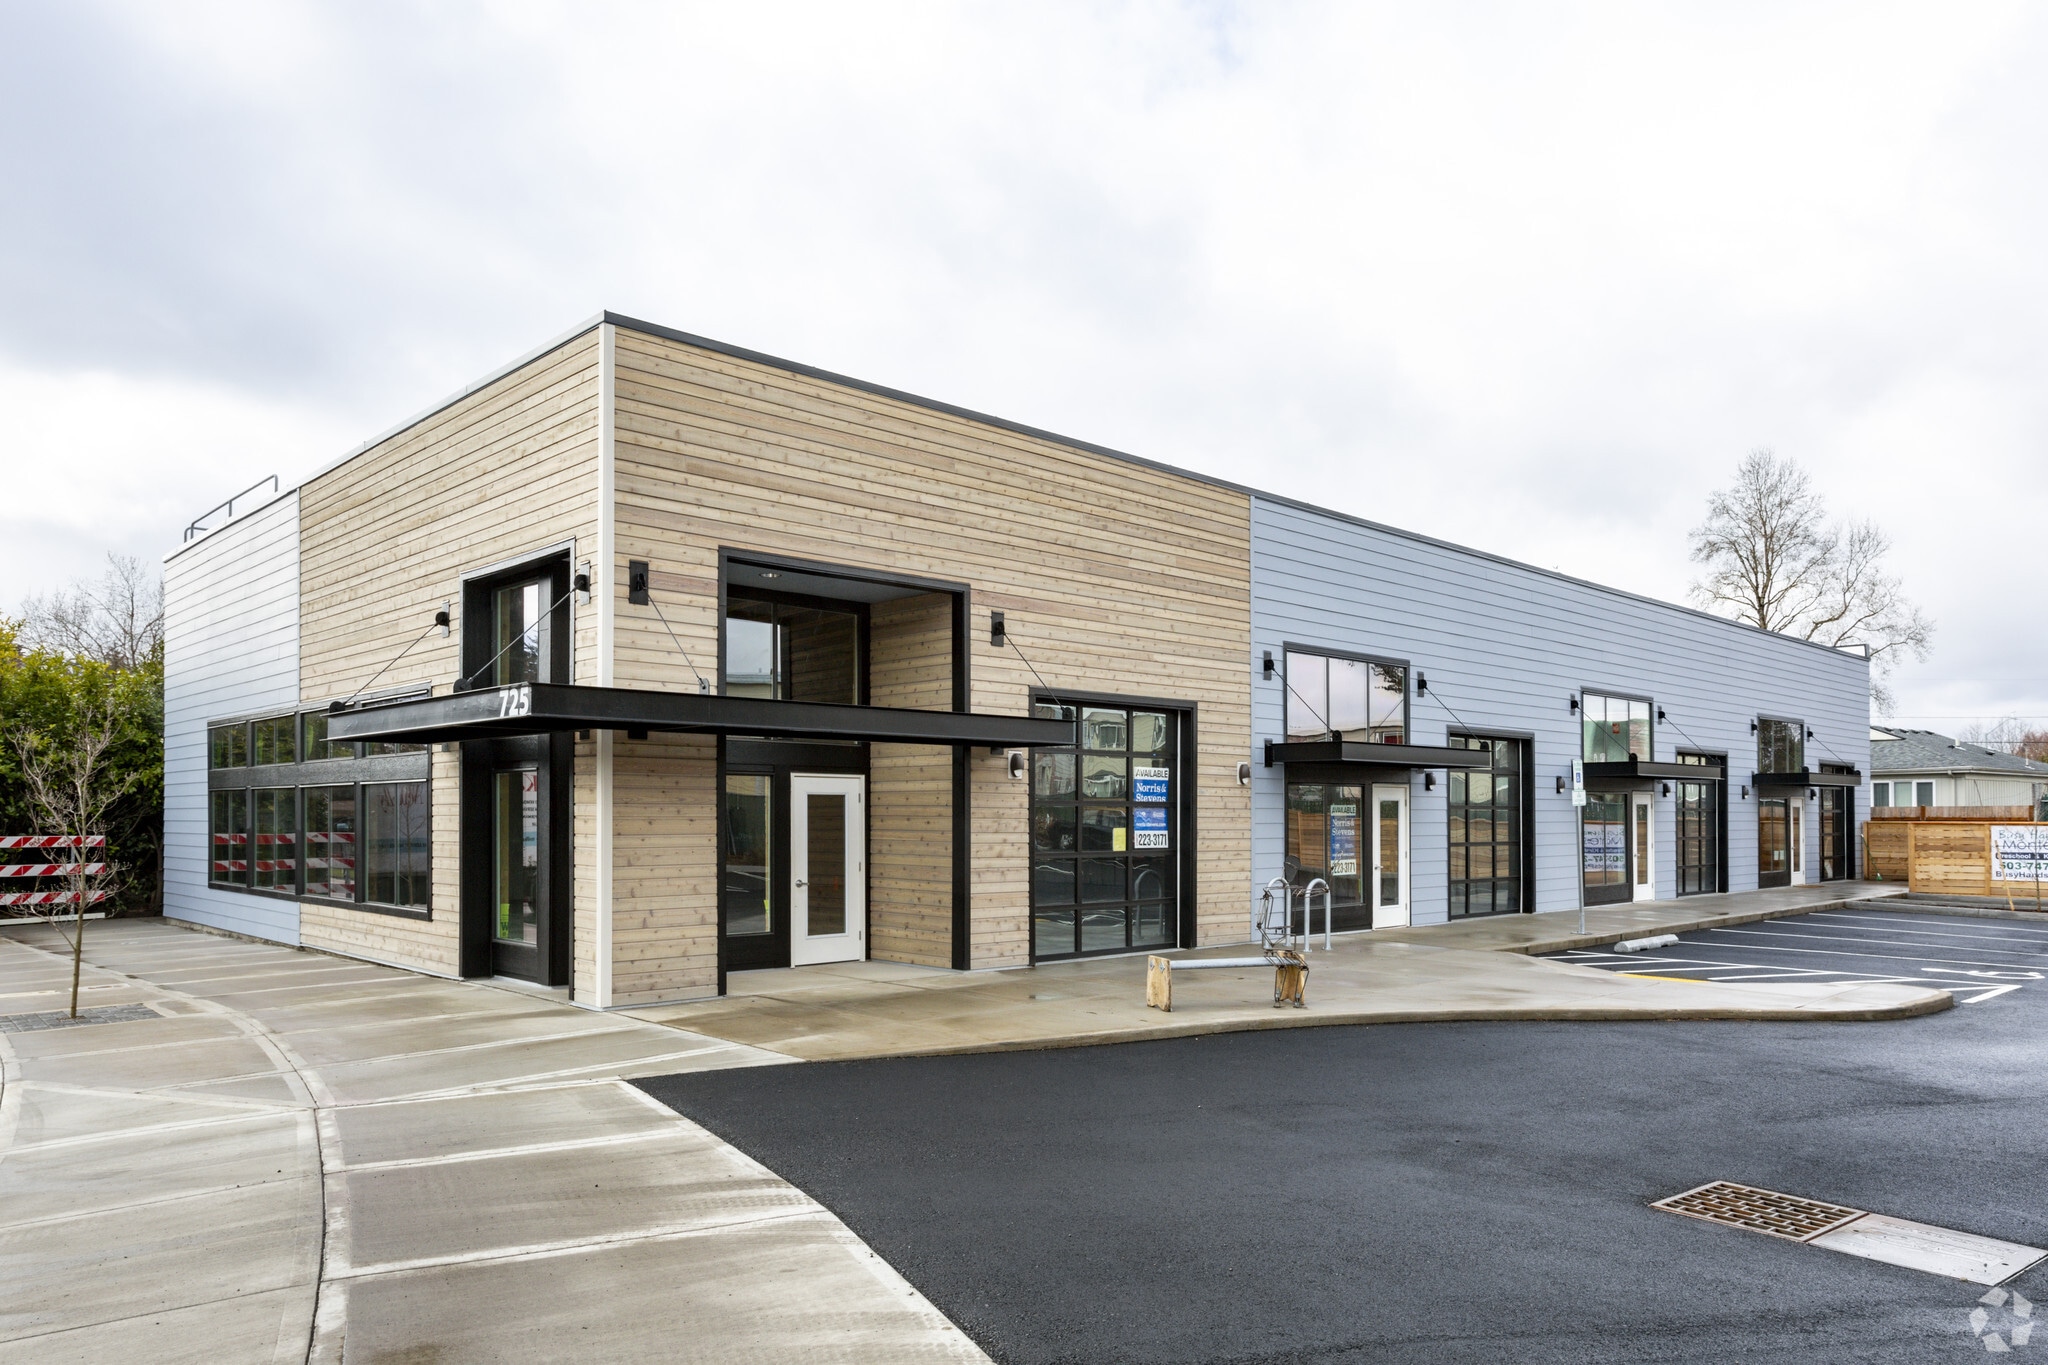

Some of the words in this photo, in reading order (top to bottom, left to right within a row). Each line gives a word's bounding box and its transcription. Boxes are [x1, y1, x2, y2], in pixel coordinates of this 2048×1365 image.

[499, 687, 529, 718] 725
[1135, 769, 1168, 778] AVAILABLE
[1135, 793, 1167, 802] Stevens
[1331, 806, 1356, 814] AVAILABLE
[1331, 827, 1355, 836] Stevens
[1999, 829, 2026, 840] Busy
[1138, 834, 1167, 846] 223-3171
